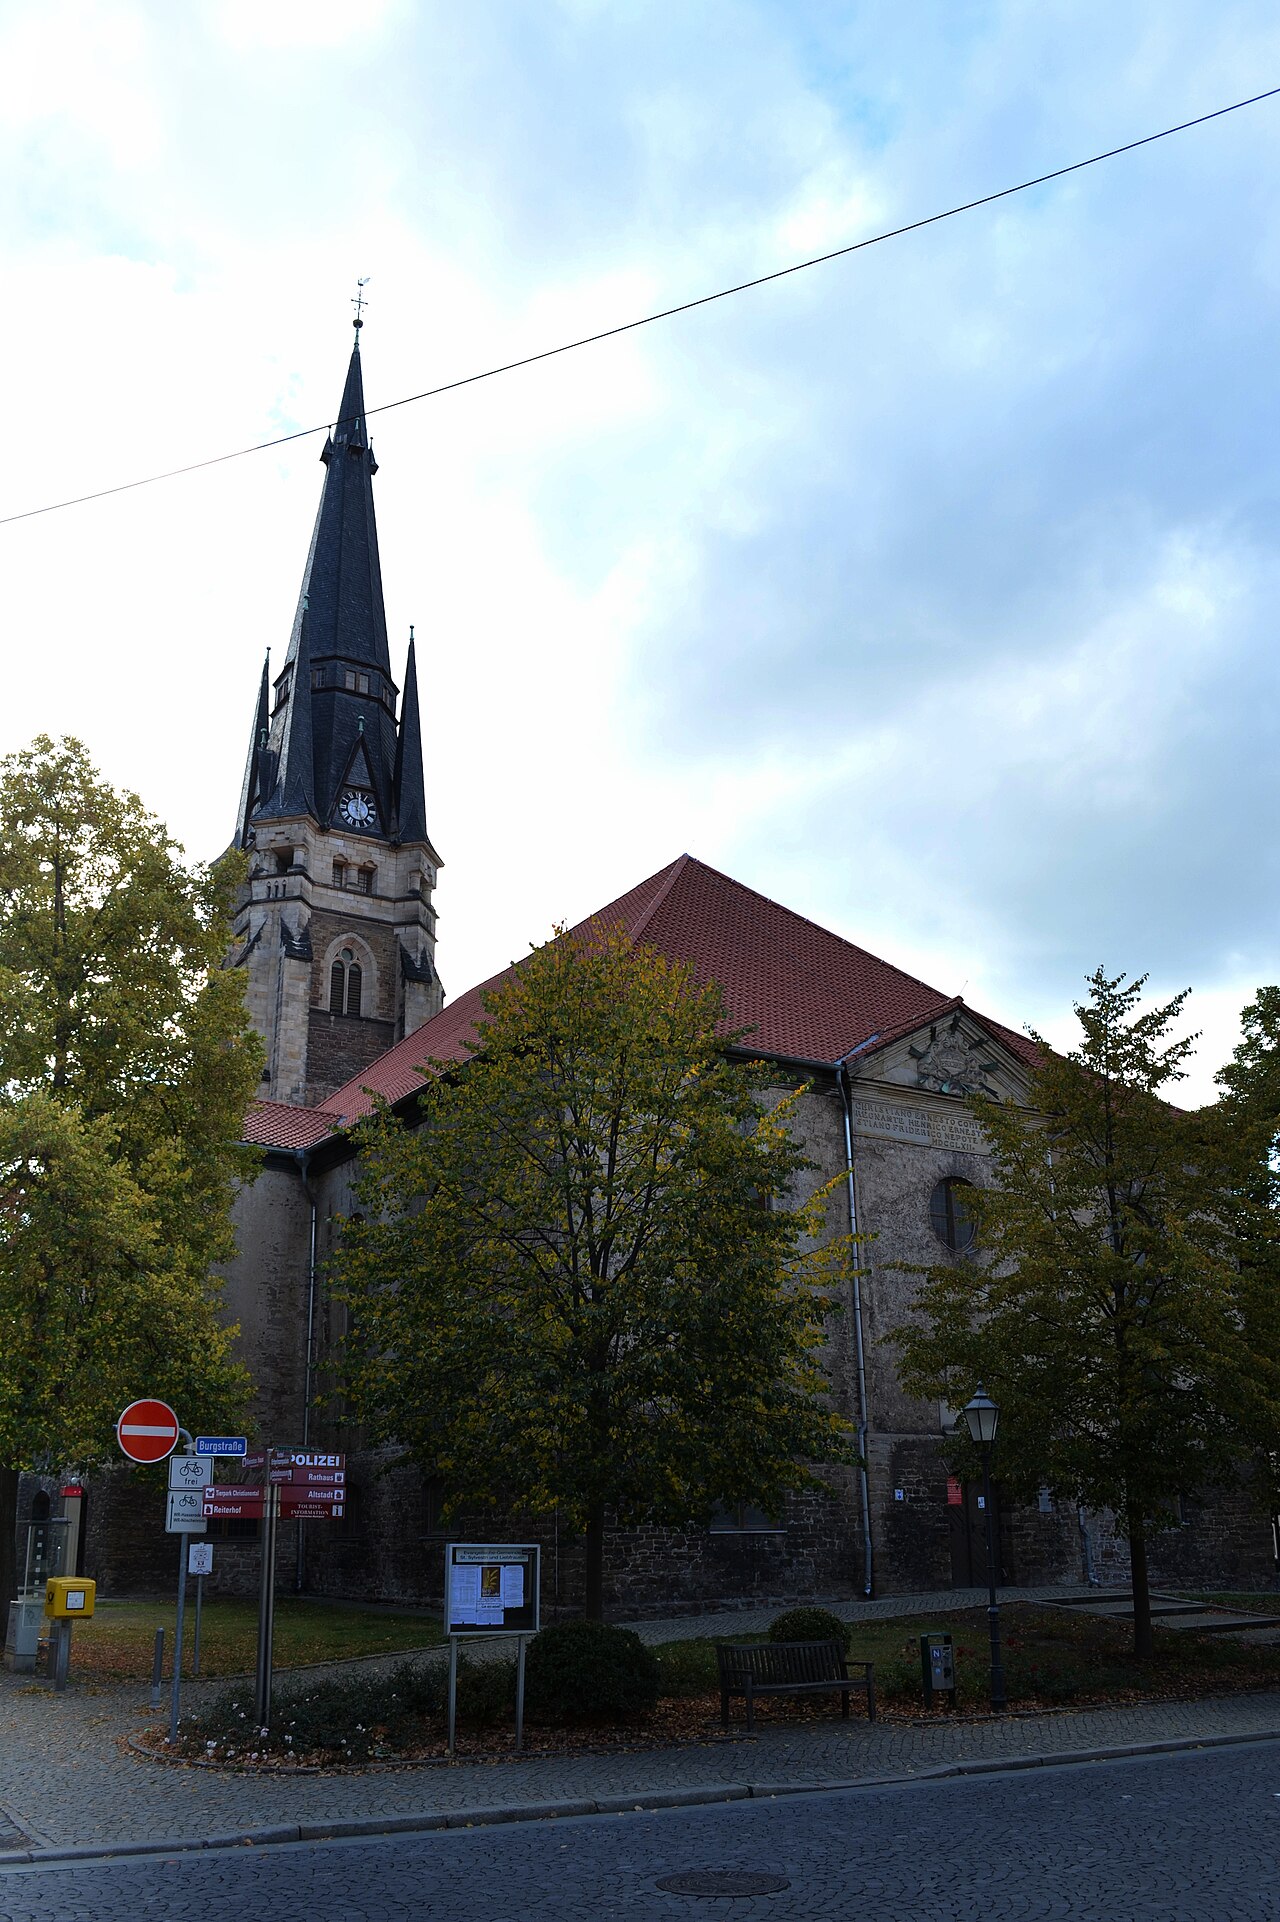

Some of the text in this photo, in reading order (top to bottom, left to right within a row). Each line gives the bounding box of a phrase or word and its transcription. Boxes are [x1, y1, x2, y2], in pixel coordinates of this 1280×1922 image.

[855, 1102, 912, 1118] CHRISTIANO
[915, 1111, 956, 1126] ERNESTO
[855, 1109, 905, 1125] REGNANTE
[908, 1118, 947, 1132] HENRICO
[857, 1118, 891, 1131] STIANO
[893, 1123, 942, 1139] FRIDERICO
[944, 1132, 979, 1145] NEPOTE
[199, 1440, 243, 1453] Burgstraße
[184, 1477, 198, 1486] frei
[308, 1473, 334, 1481] Rathaus
[215, 1489, 232, 1498] Tierpark
[307, 1490, 334, 1499] Altstadt
[214, 1505, 242, 1514] Reiterhof
